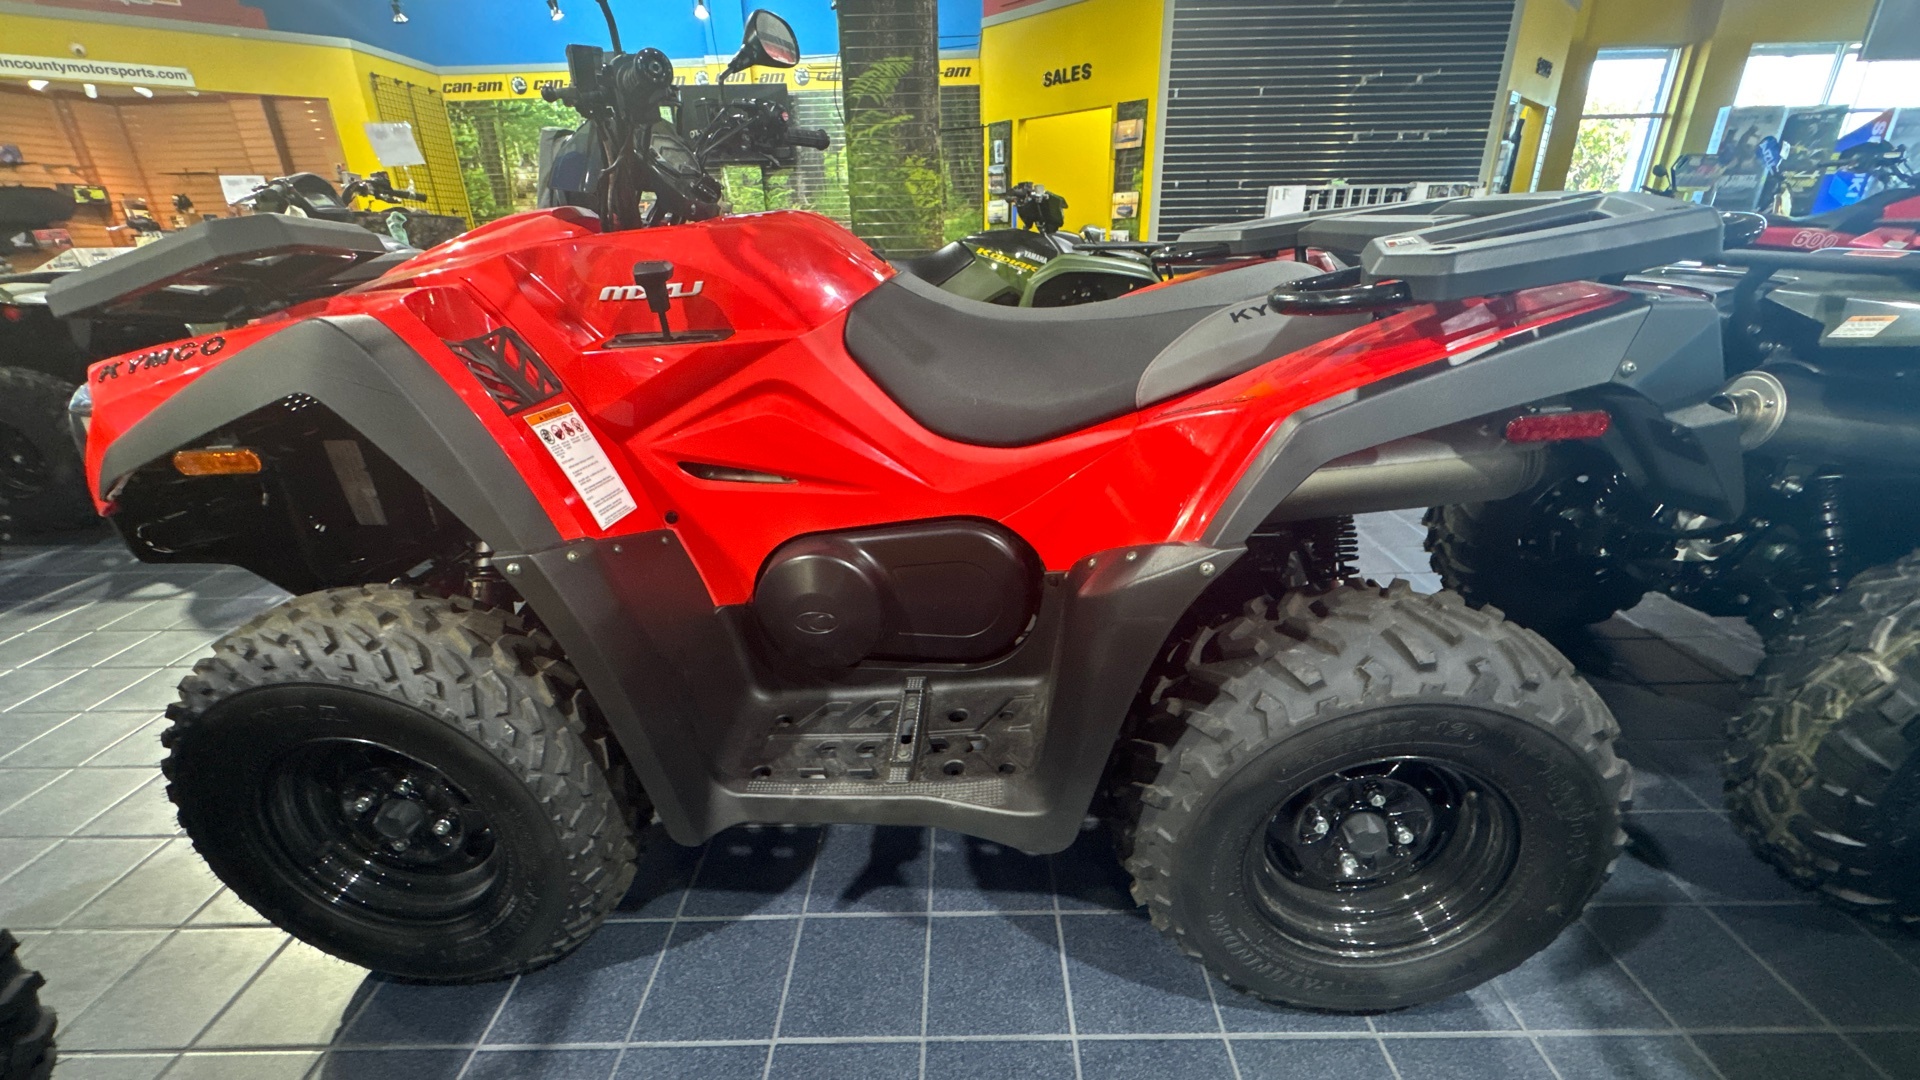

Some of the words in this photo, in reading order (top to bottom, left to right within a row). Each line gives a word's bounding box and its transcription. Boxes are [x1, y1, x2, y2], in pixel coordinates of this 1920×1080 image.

[1043, 63, 1092, 87] SALES
[442, 80, 503, 93] can-am
[1791, 228, 1839, 249] 600
[975, 247, 1039, 273] KODIAK
[1024, 250, 1048, 265] YAMAHA
[98, 336, 226, 383] KYMCO
